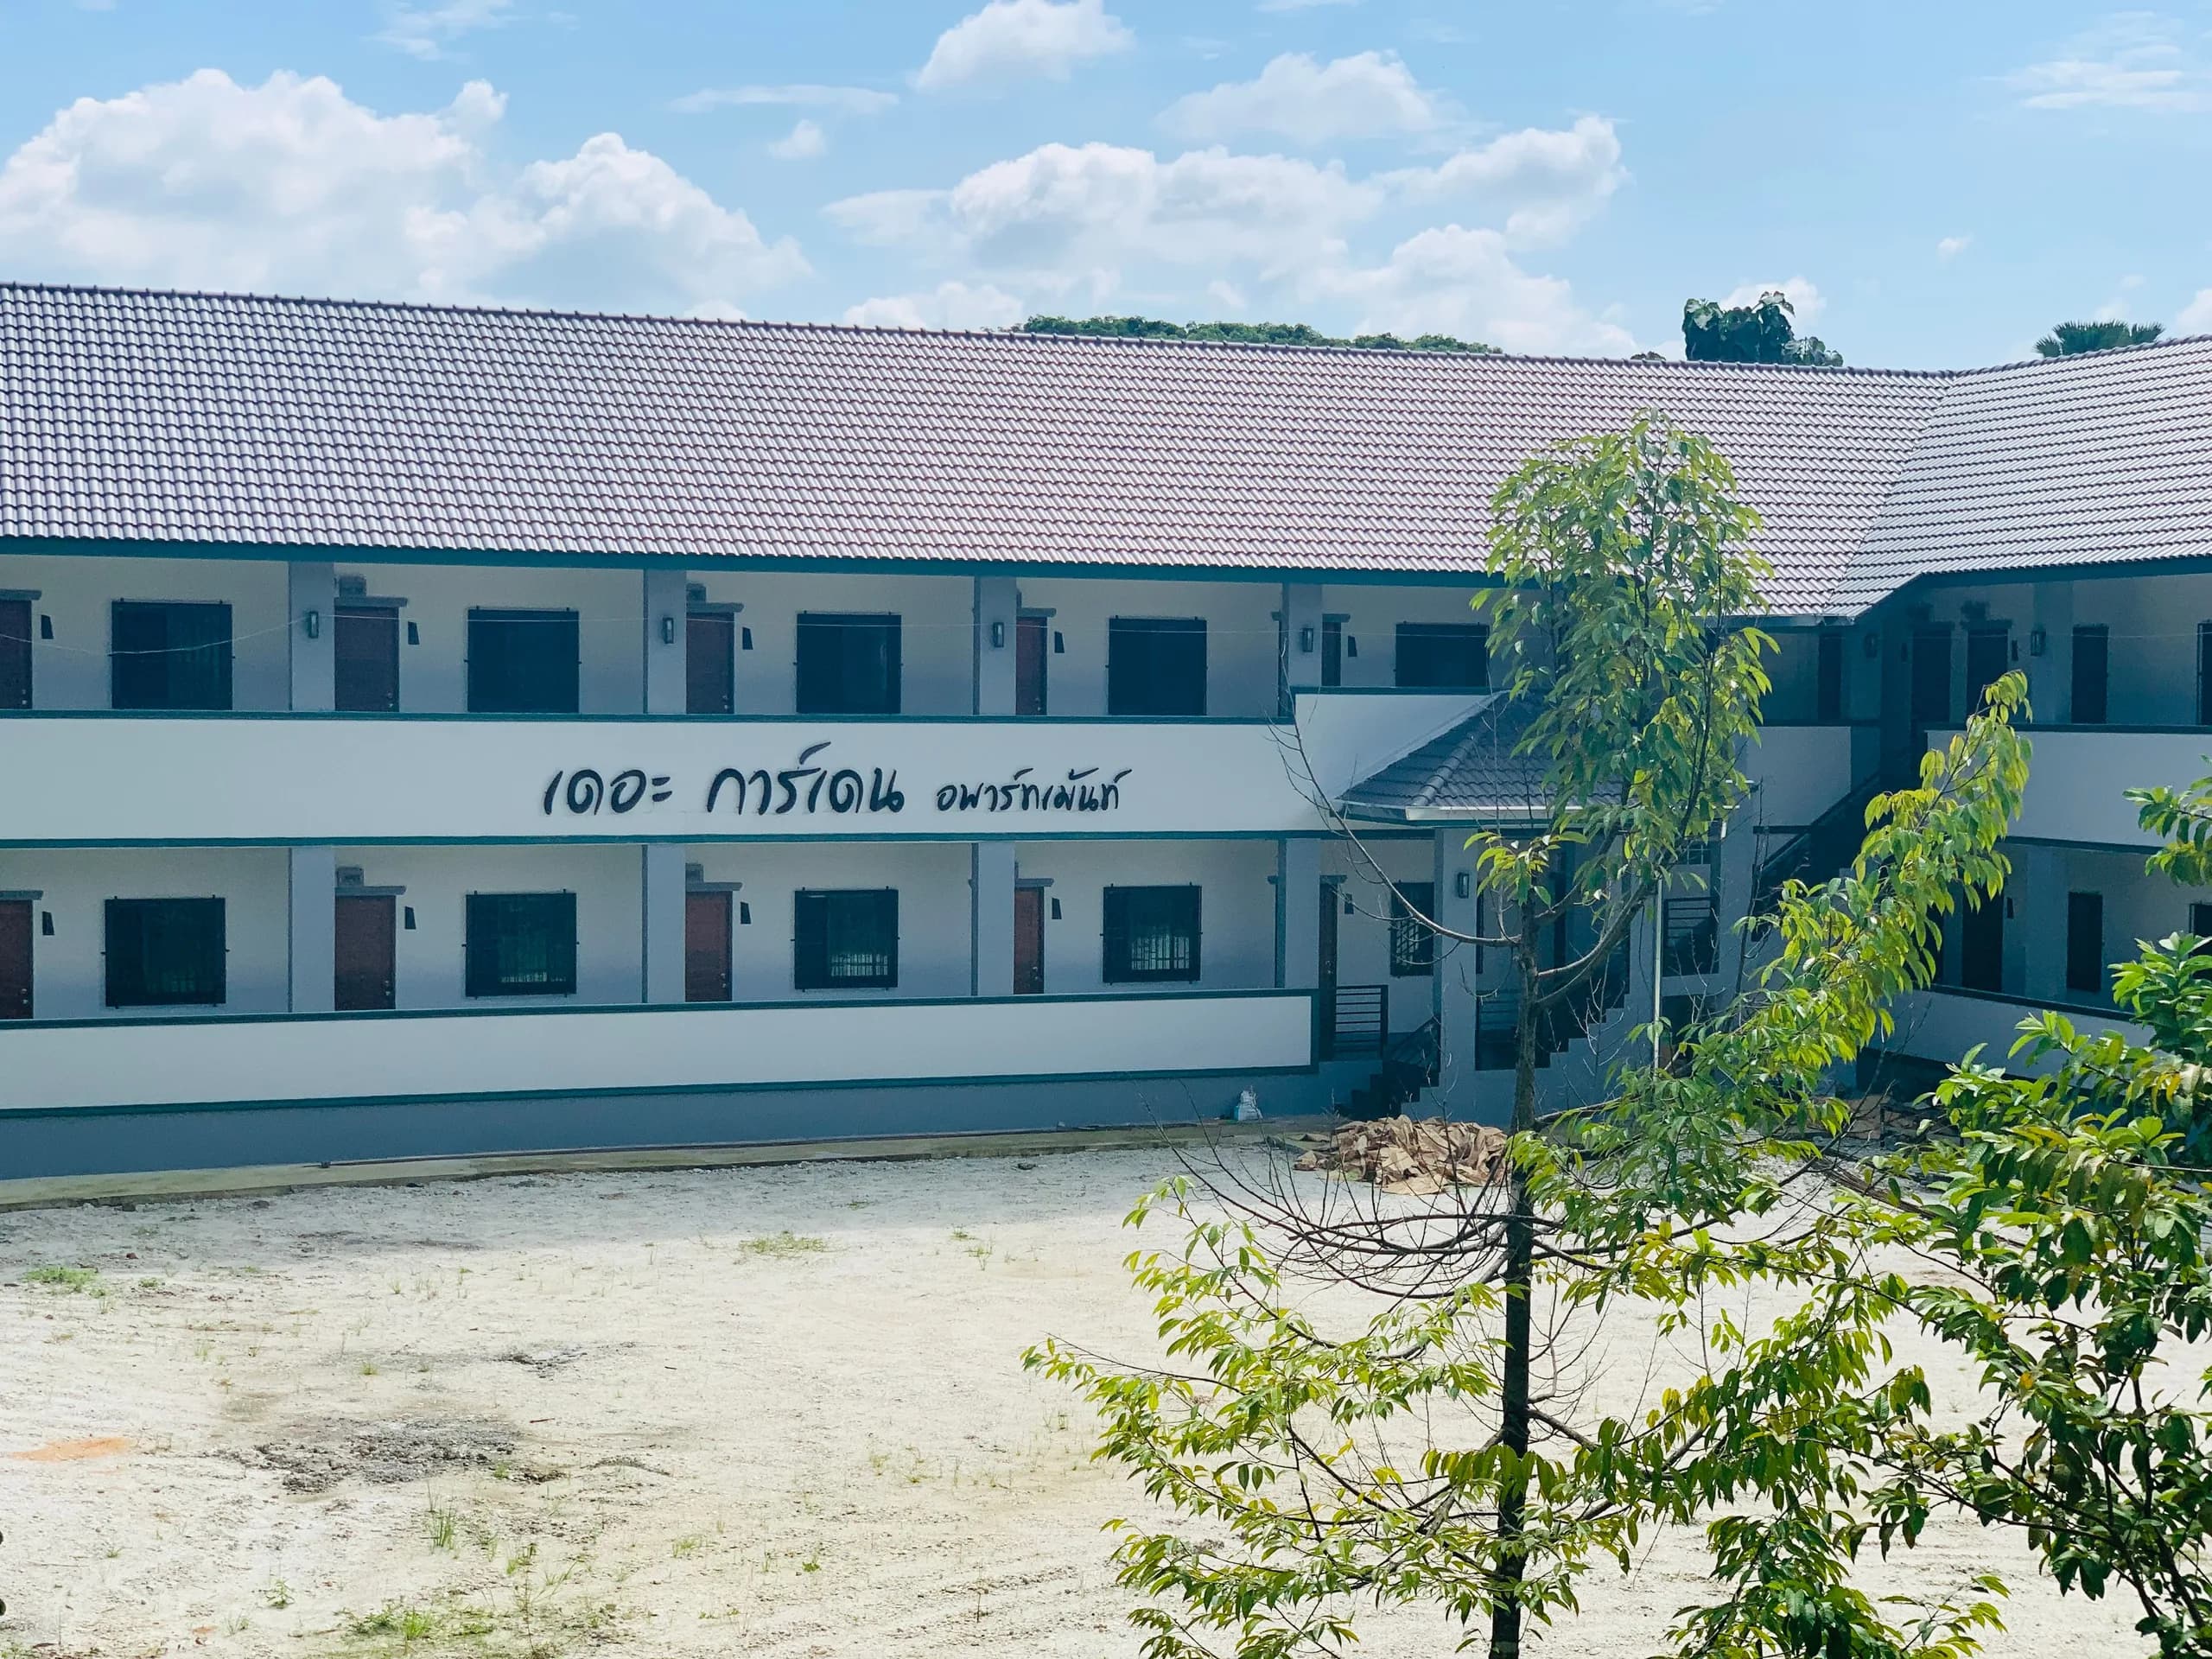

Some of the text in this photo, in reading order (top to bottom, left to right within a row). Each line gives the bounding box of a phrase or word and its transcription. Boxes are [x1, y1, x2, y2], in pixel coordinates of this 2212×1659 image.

[543, 767, 673, 816] เดอะ
[705, 741, 906, 816] การ์เดน
